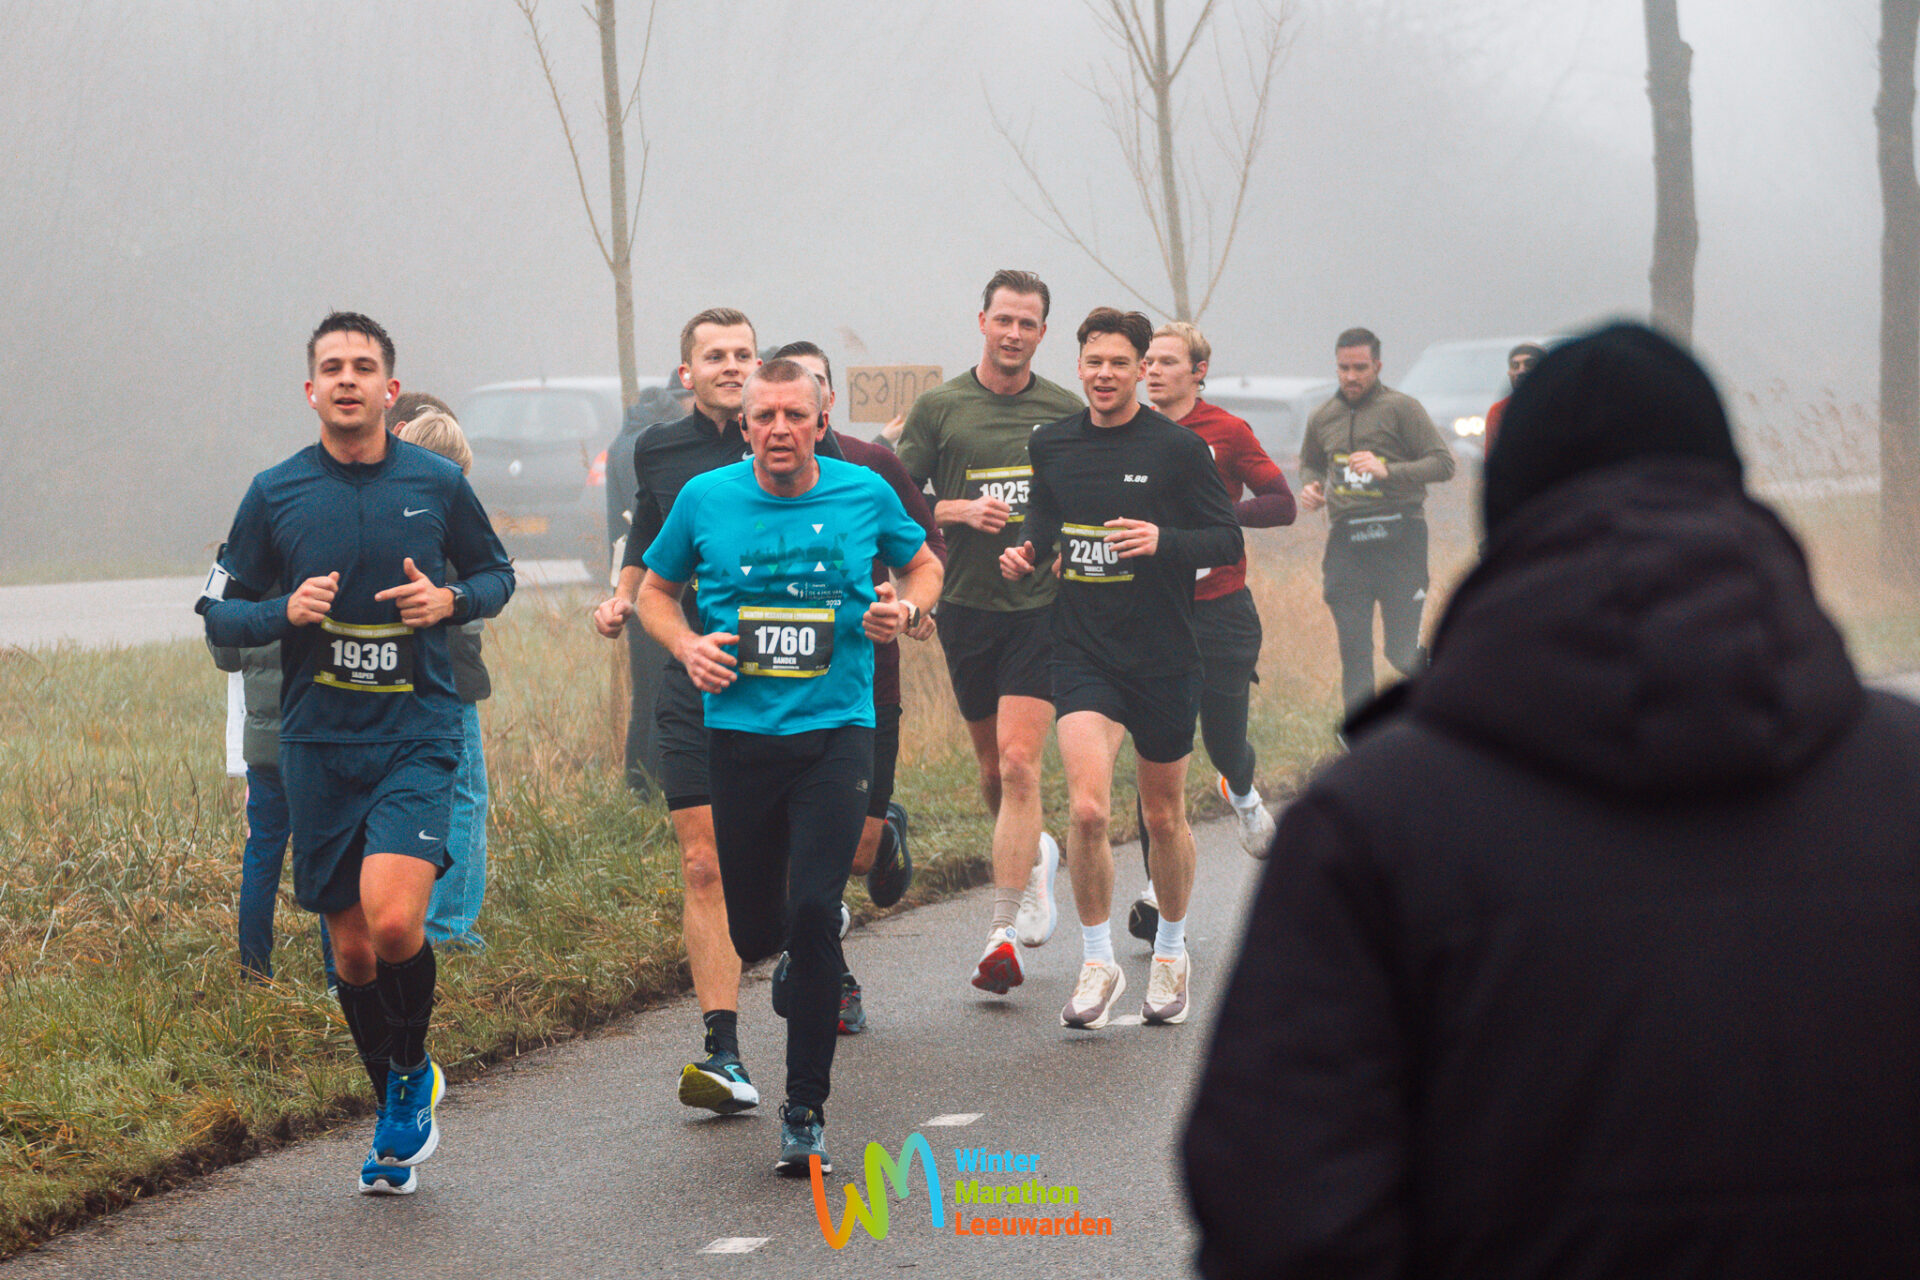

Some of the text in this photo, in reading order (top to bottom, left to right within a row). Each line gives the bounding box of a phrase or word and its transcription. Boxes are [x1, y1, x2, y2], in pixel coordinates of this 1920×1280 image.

[979, 480, 1030, 505] 1925
[1069, 539, 1119, 565] 2240
[755, 625, 816, 656] 1760
[330, 639, 398, 671] 1936
